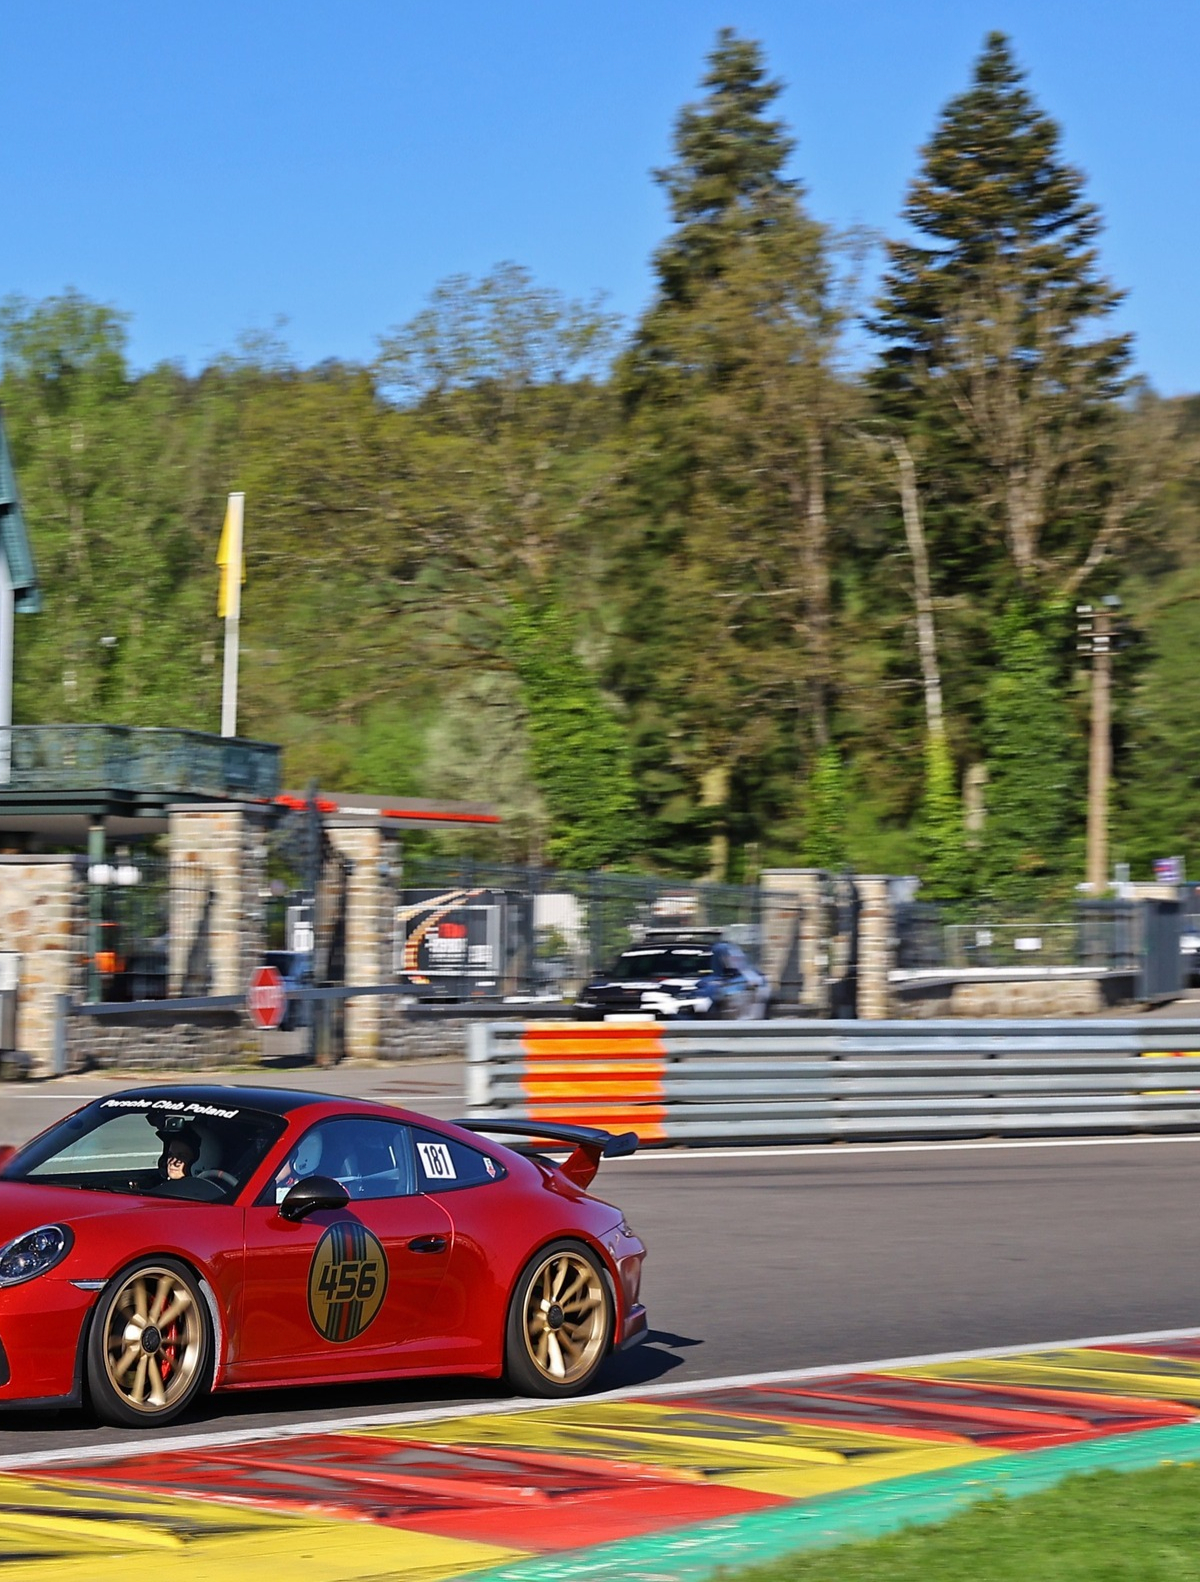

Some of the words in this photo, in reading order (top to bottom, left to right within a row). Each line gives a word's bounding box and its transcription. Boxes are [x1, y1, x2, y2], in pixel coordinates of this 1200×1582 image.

[100, 1099, 152, 1108] Porsche
[152, 1100, 185, 1110] Club
[183, 1103, 239, 1119] Poland
[423, 1145, 451, 1176] 181
[317, 1261, 379, 1302] 456
